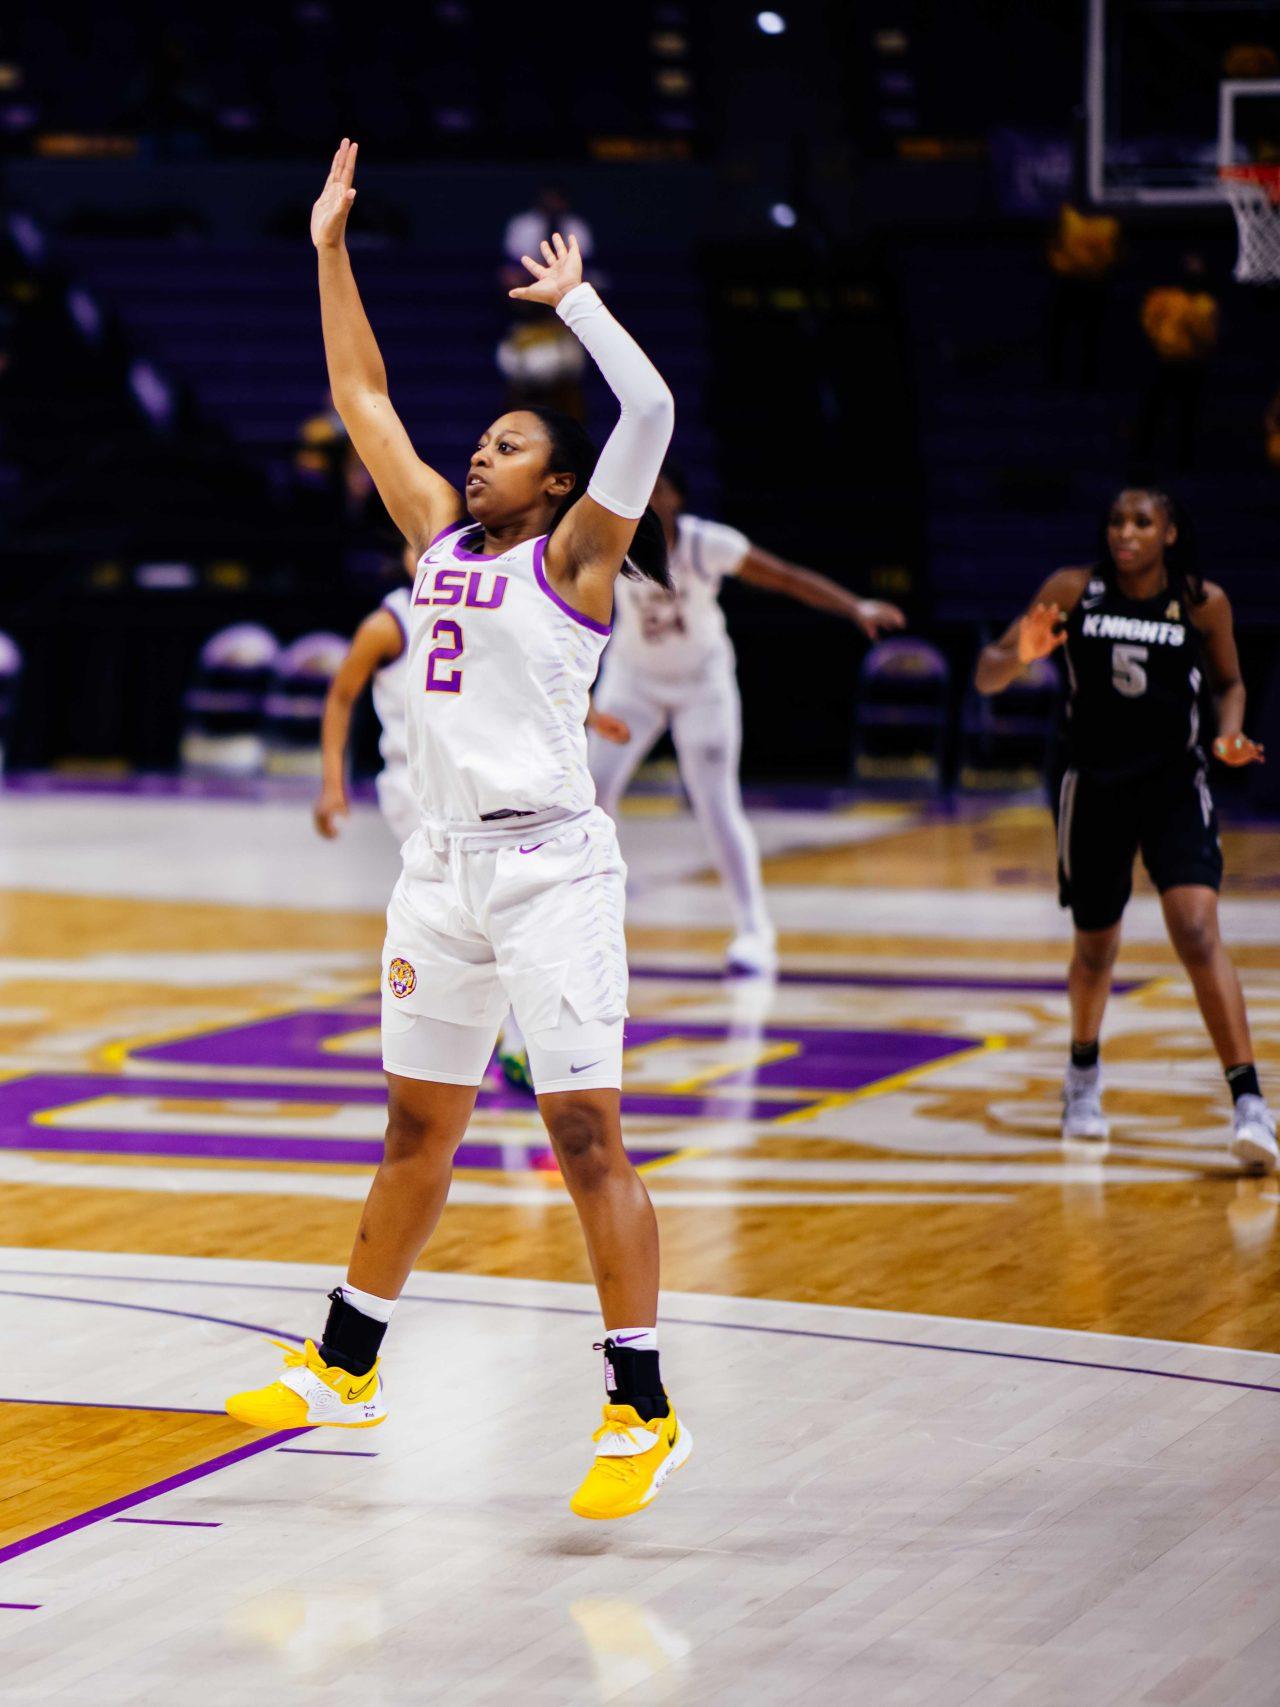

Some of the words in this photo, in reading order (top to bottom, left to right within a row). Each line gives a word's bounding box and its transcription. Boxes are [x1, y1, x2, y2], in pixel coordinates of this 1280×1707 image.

[413, 569, 508, 609] LSU
[1082, 613, 1186, 647] KNIGHTS
[425, 618, 464, 694] 2
[1111, 643, 1149, 698] 5
